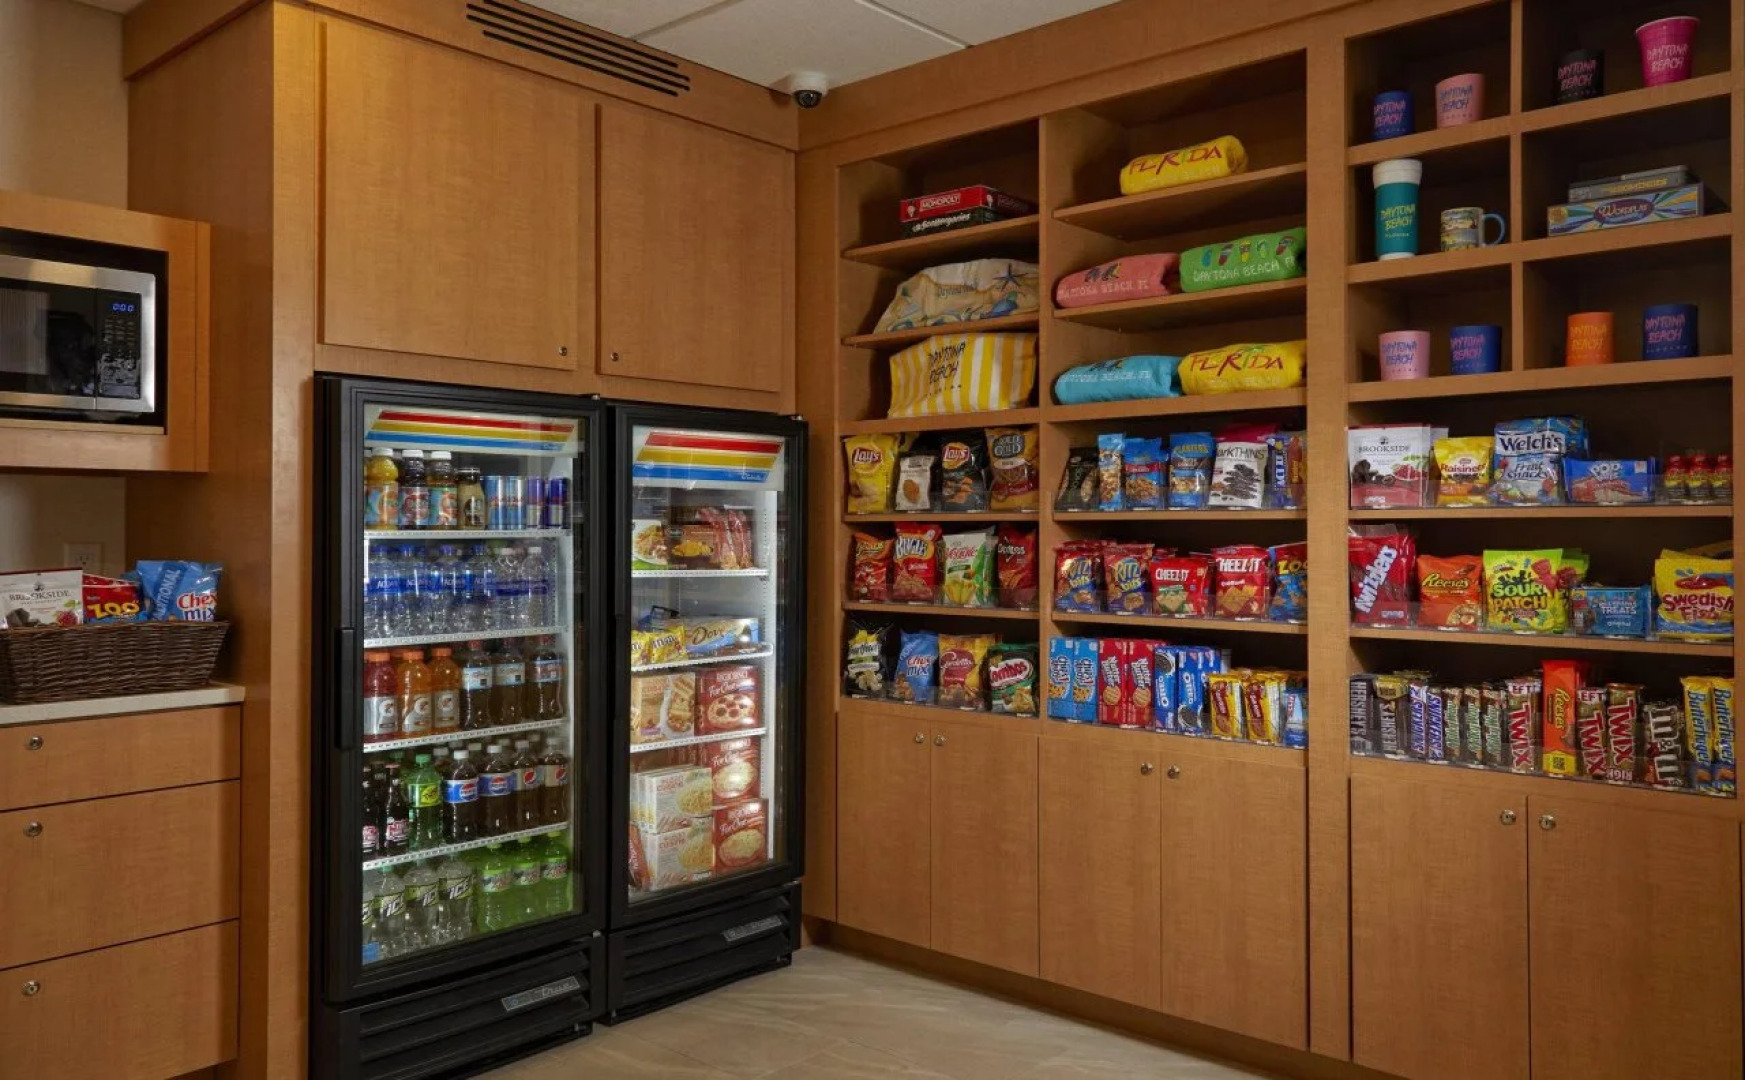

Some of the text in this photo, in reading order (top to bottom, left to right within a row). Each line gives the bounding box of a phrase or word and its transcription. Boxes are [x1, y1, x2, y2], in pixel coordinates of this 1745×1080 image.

[1647, 43, 1688, 60] DAYTONA
[1557, 58, 1597, 79] DAYTONA
[1651, 57, 1684, 72] BEACH
[1561, 73, 1592, 91] BEACH
[922, 194, 960, 209] MONOPOLY
[1381, 203, 1416, 219] DAYTONA
[1384, 216, 1412, 231] BEACH
[1193, 268, 1240, 283] DAYTONA
[1244, 258, 1280, 276] BEACH
[1102, 281, 1132, 294] BEACH
[1645, 312, 1686, 330] DAYTONA
[1570, 324, 1607, 339] DAYTONA
[1648, 329, 1682, 344] BEACH
[1381, 340, 1417, 354] DAYTONA
[1450, 334, 1485, 349] DAYTONA
[1572, 338, 1604, 350] BEACH
[929, 341, 966, 364] DAYTONA
[1385, 353, 1414, 366] BEACH
[1453, 348, 1482, 360] BEACH
[930, 360, 959, 384] BEACH
[1358, 444, 1411, 454] BROOKSIDE
[1499, 432, 1563, 453] Welch's
[854, 448, 882, 464] Lay's
[944, 445, 970, 461] Lay's
[998, 543, 1026, 555] Doritos
[1115, 560, 1141, 582] RITZ
[1493, 583, 1542, 598] SOUR
[177, 593, 218, 610] Chex
[1494, 597, 1547, 610] PATCH
[1662, 593, 1734, 612] Swedish
[87, 601, 140, 619] ZOO
[183, 607, 215, 622] mix
[1602, 606, 1637, 615] TREATS
[1680, 606, 1719, 620] Fish
[906, 665, 930, 676] mix
[1156, 676, 1168, 707] OREO
[1182, 671, 1194, 705] OREO
[1350, 681, 1367, 736] HERSHEY'S
[1380, 701, 1396, 751] HERSHEY'S
[1410, 701, 1425, 754] SNICKERS
[1428, 693, 1443, 748] SNICKERS
[1508, 702, 1534, 768] TWIX
[1607, 697, 1637, 765] TWIX
[1579, 710, 1607, 776] TWIX
